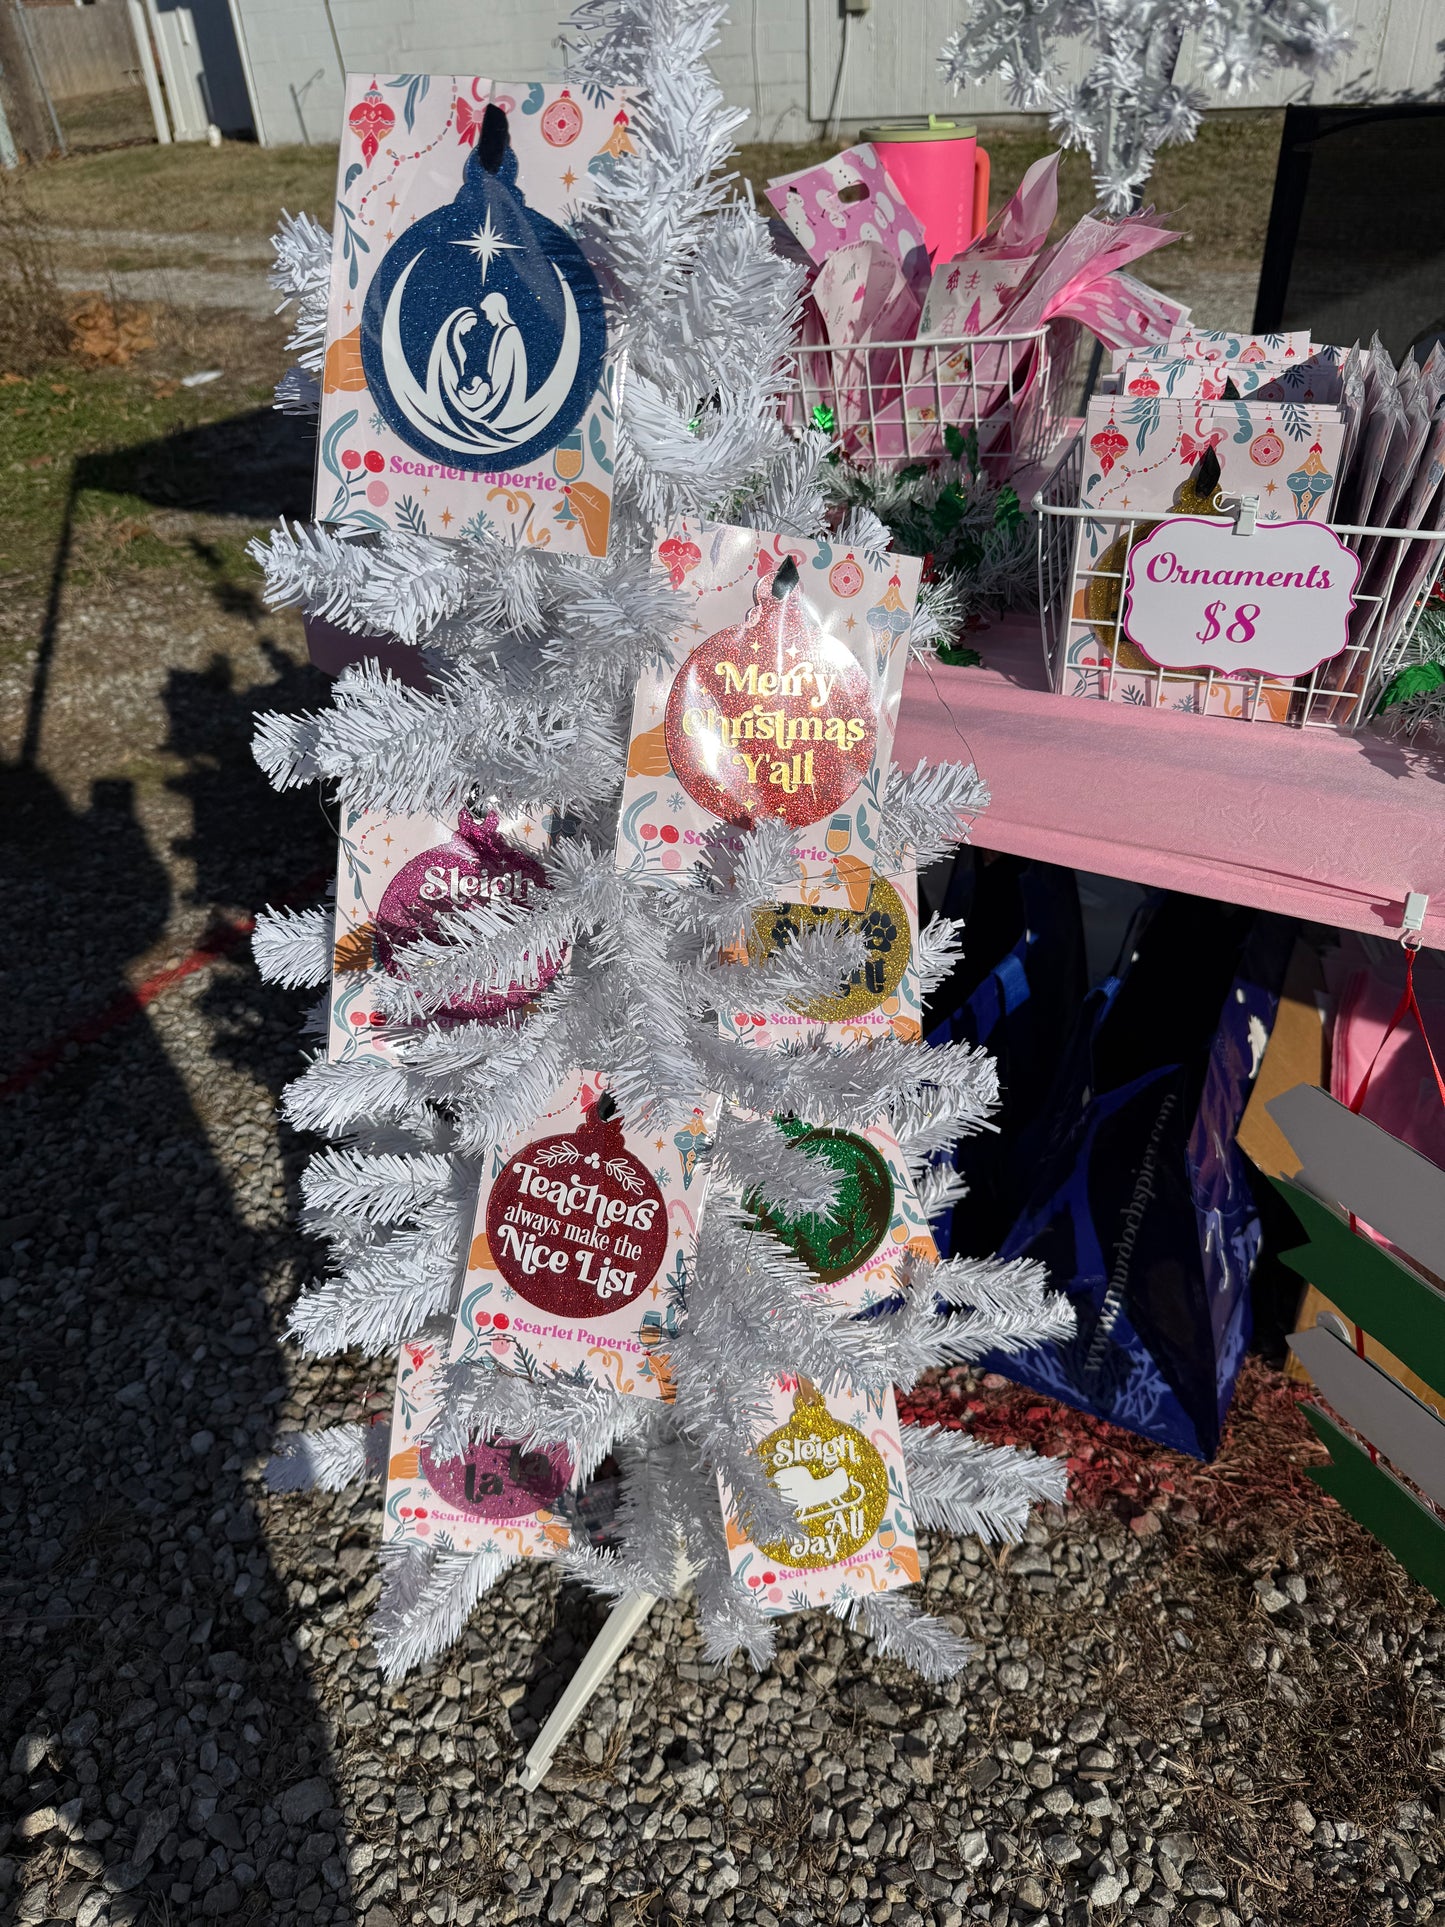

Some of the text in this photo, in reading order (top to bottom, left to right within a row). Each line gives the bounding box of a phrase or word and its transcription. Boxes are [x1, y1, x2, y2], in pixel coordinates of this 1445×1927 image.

[1146, 552, 1334, 589] Ornaments
[1195, 600, 1261, 645] $8
[714, 661, 836, 707] Merry
[682, 704, 865, 751] Christmas
[732, 750, 816, 794] Y'all
[683, 829, 745, 851] Scarle
[419, 866, 537, 905] Sleigh
[512, 1162, 660, 1231] Teachers
[503, 1202, 643, 1262] always make the
[1084, 1093, 1177, 1372] www.murdochspier.com
[497, 1224, 638, 1299] Nice List
[512, 1317, 641, 1353] Scarlet Paperie
[772, 1433, 862, 1469] Sleigh
[464, 1463, 505, 1504] la
[824, 1508, 864, 1539] All
